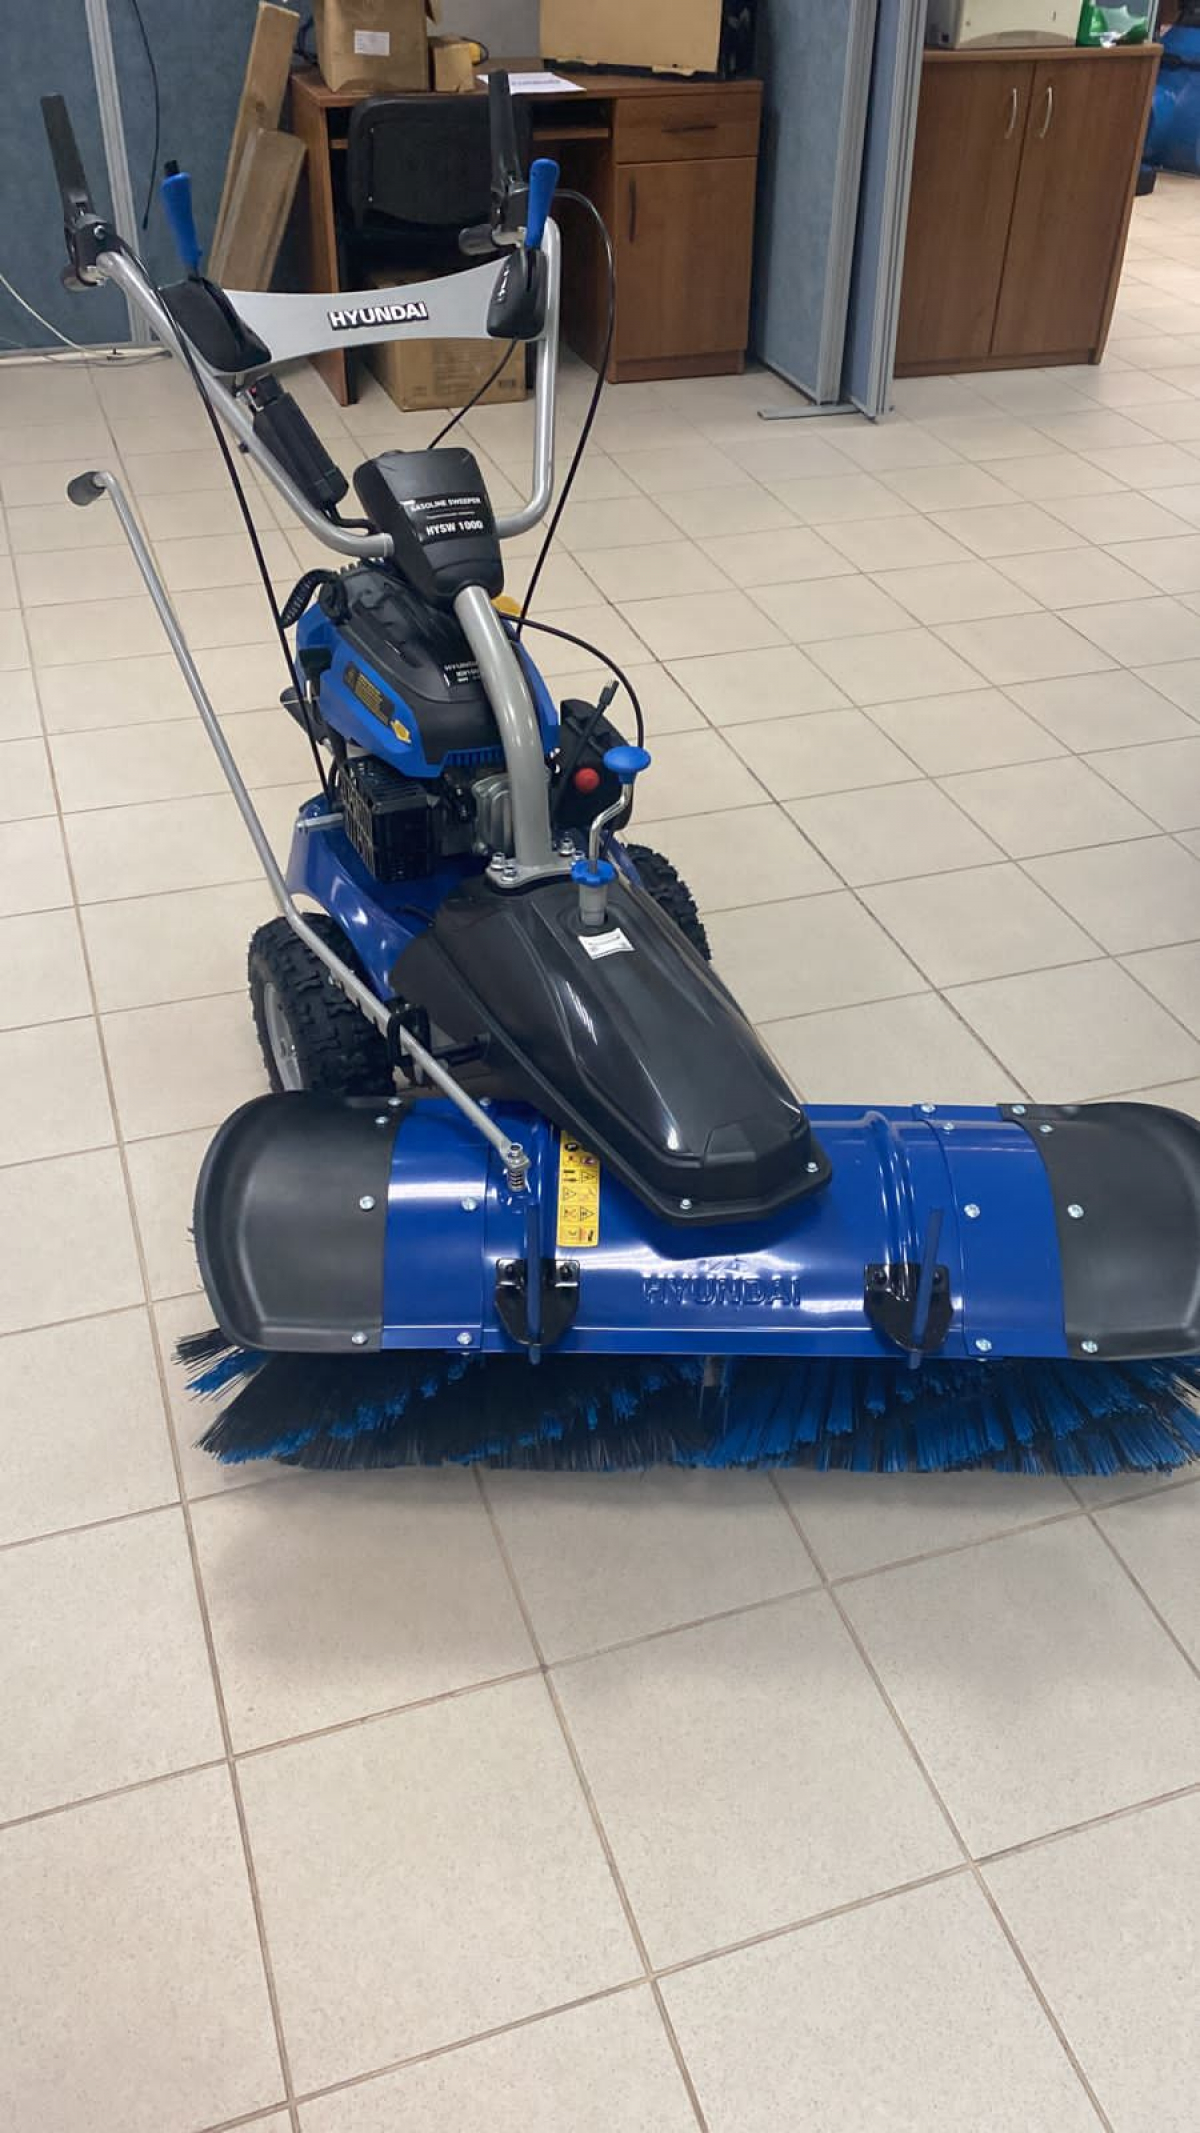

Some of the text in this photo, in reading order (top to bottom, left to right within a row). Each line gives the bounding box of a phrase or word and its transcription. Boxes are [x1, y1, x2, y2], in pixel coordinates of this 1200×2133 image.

[329, 302, 428, 328] HYUNDAI
[447, 496, 481, 506] SWEEPER
[426, 520, 484, 536] HYSW 1000
[641, 1272, 801, 1309] HYUNDAI
